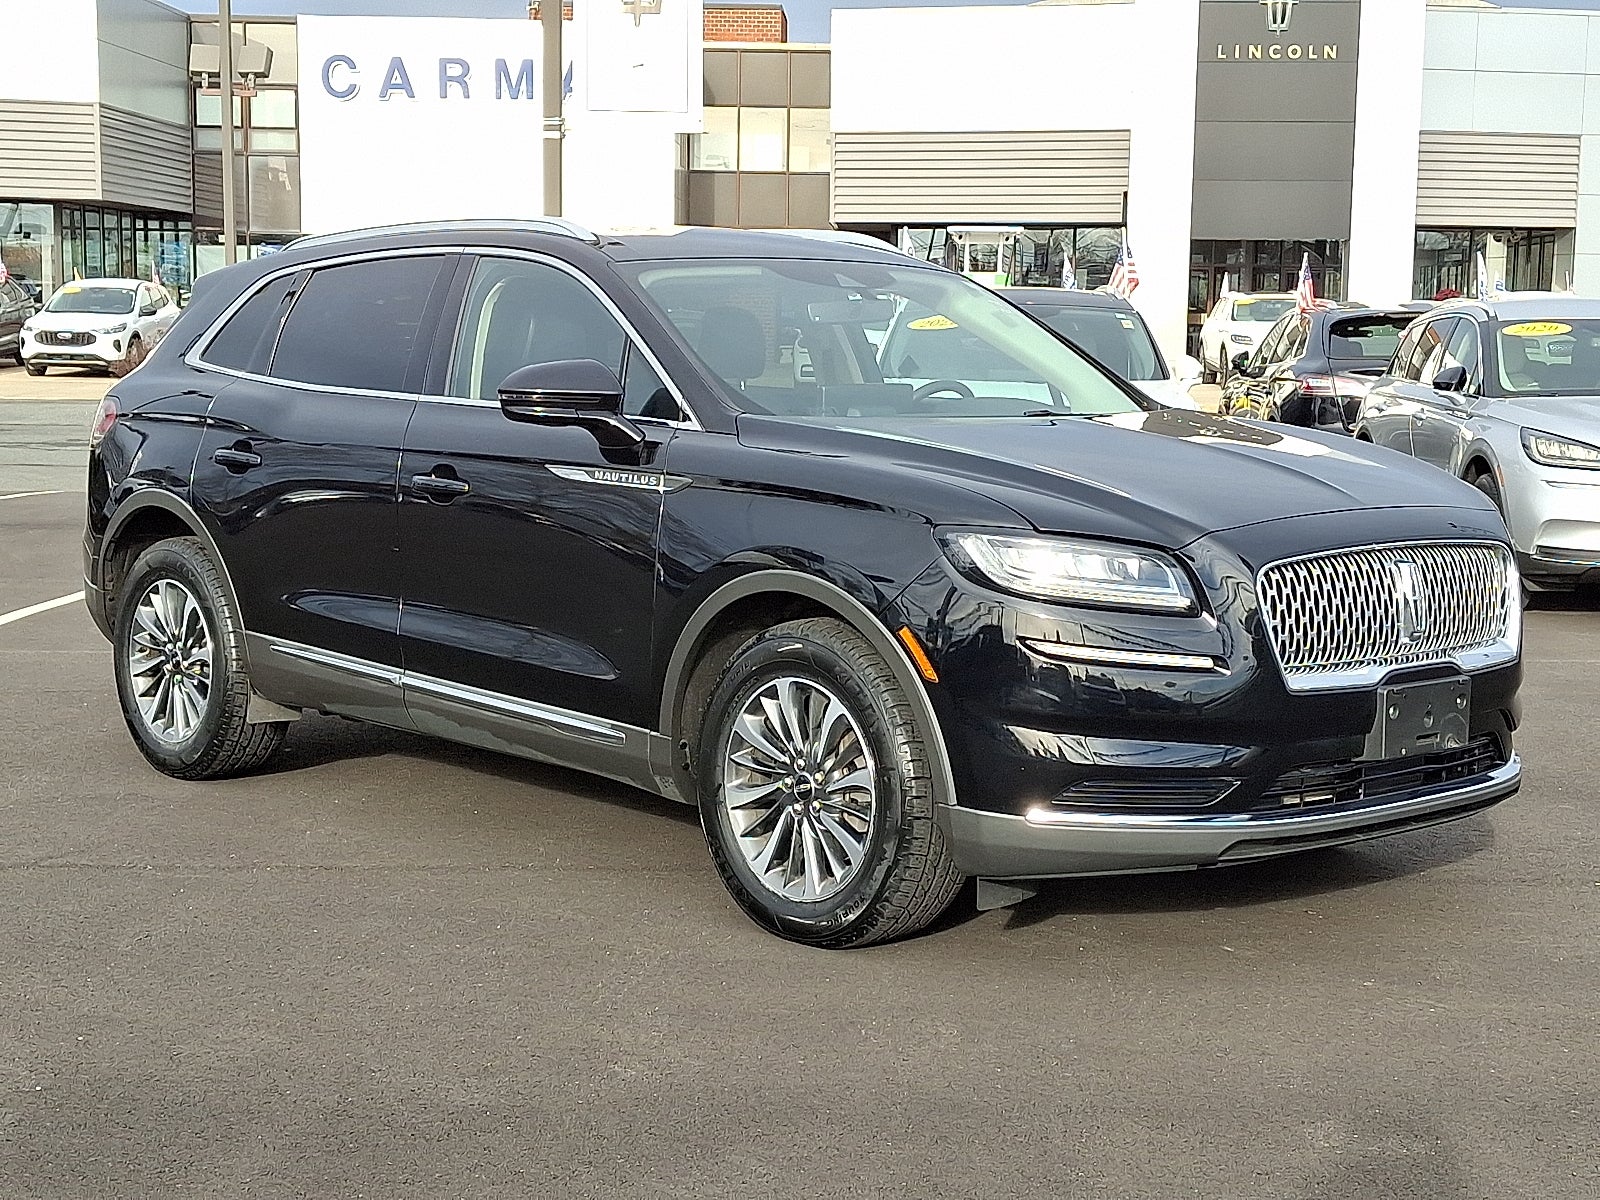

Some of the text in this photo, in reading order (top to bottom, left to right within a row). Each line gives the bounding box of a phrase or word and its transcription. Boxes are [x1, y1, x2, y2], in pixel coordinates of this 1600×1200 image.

[1216, 44, 1338, 60] LINCOLN
[321, 55, 573, 100] CARM
[594, 470, 658, 486] NAUTILUS
